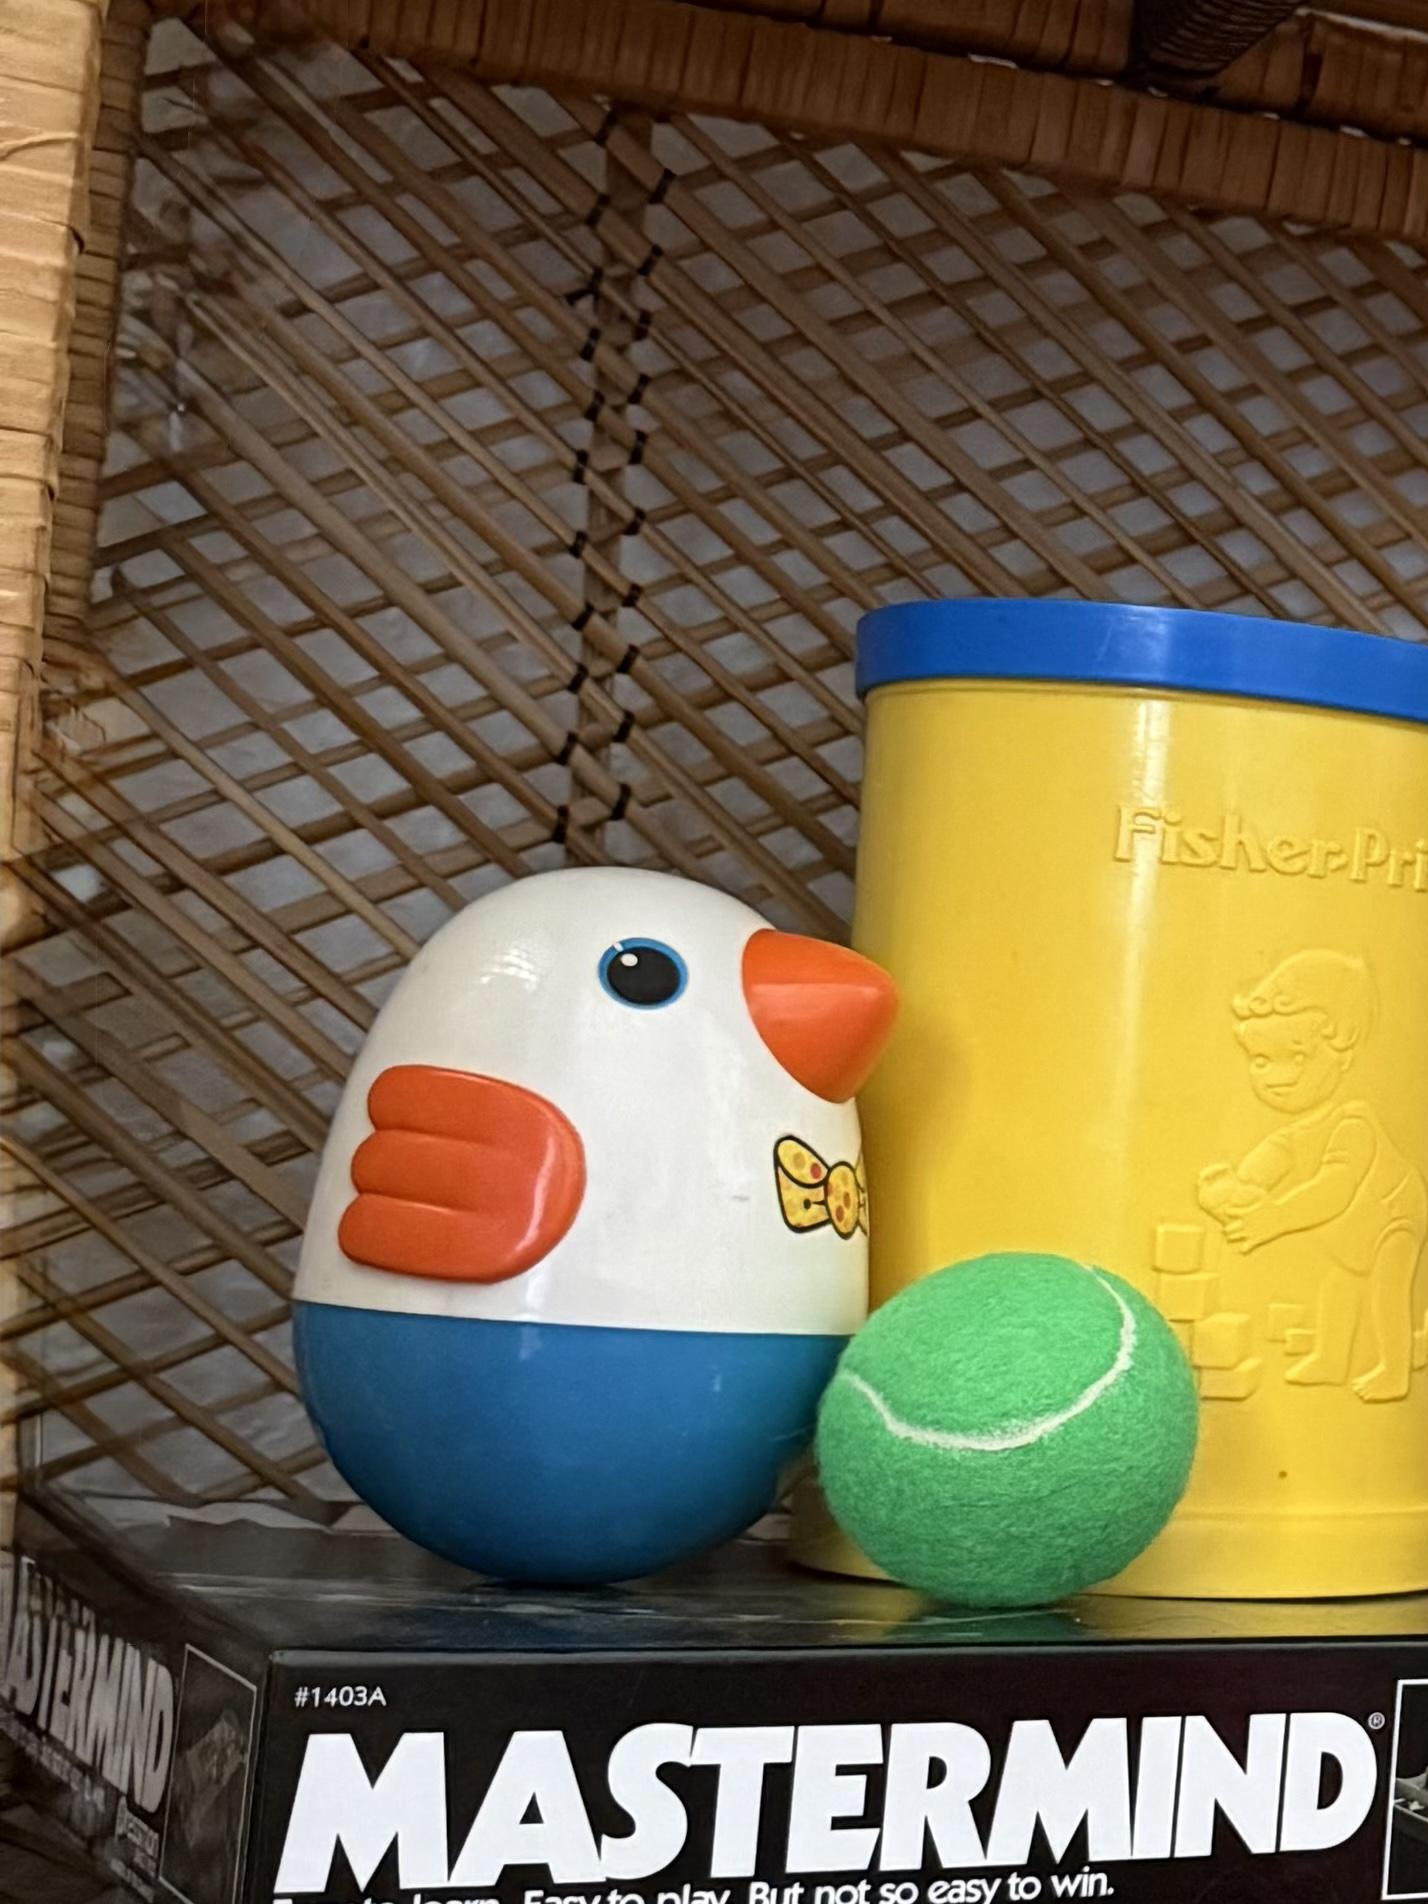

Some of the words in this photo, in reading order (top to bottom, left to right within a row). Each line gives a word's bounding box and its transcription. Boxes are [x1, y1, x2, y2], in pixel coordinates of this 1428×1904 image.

[294, 1686, 387, 1707] #1403A
[273, 1712, 1378, 1893] MASTERMIND
[1007, 1870, 1042, 1900] to
[1050, 1866, 1115, 1898] win.
